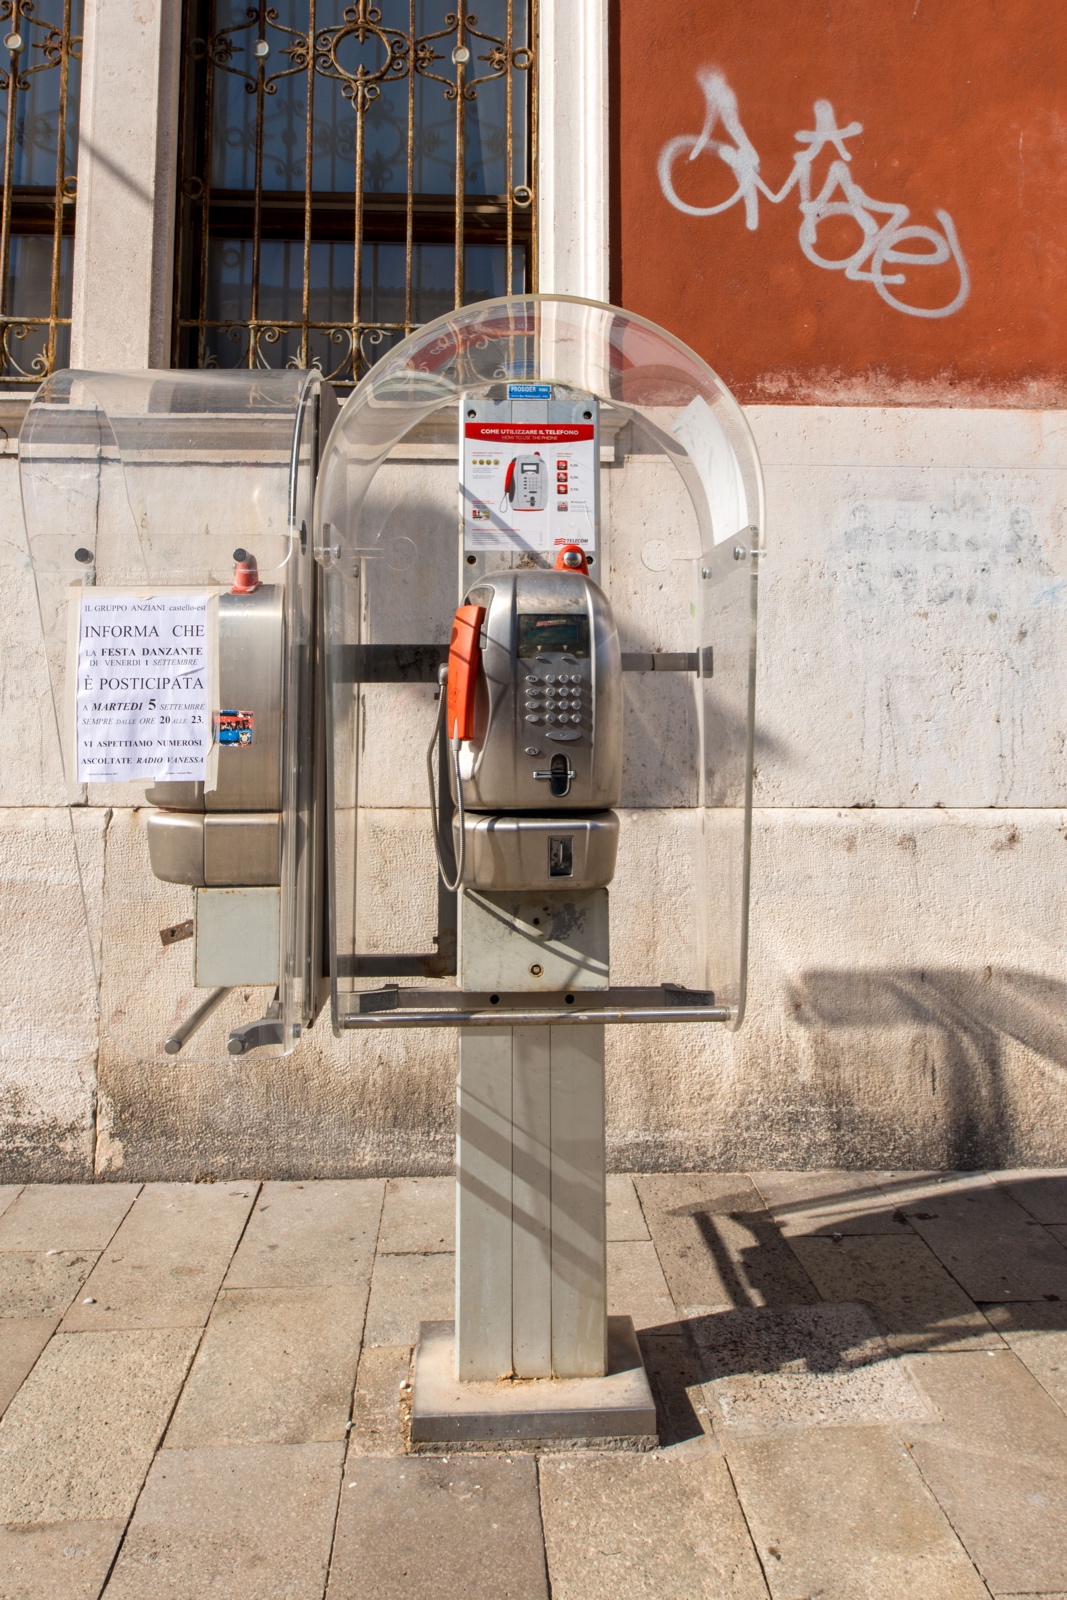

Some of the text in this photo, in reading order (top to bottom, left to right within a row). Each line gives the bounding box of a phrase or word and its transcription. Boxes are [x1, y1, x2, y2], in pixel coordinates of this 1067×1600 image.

[84, 624, 204, 638] INFORMA CHE
[102, 648, 136, 656] FESTA
[142, 647, 203, 656] DANZANTE
[84, 675, 204, 690] È POSTICIPATA
[92, 702, 144, 711] MARTEDI
[148, 699, 156, 710] 5
[160, 716, 170, 724] 20
